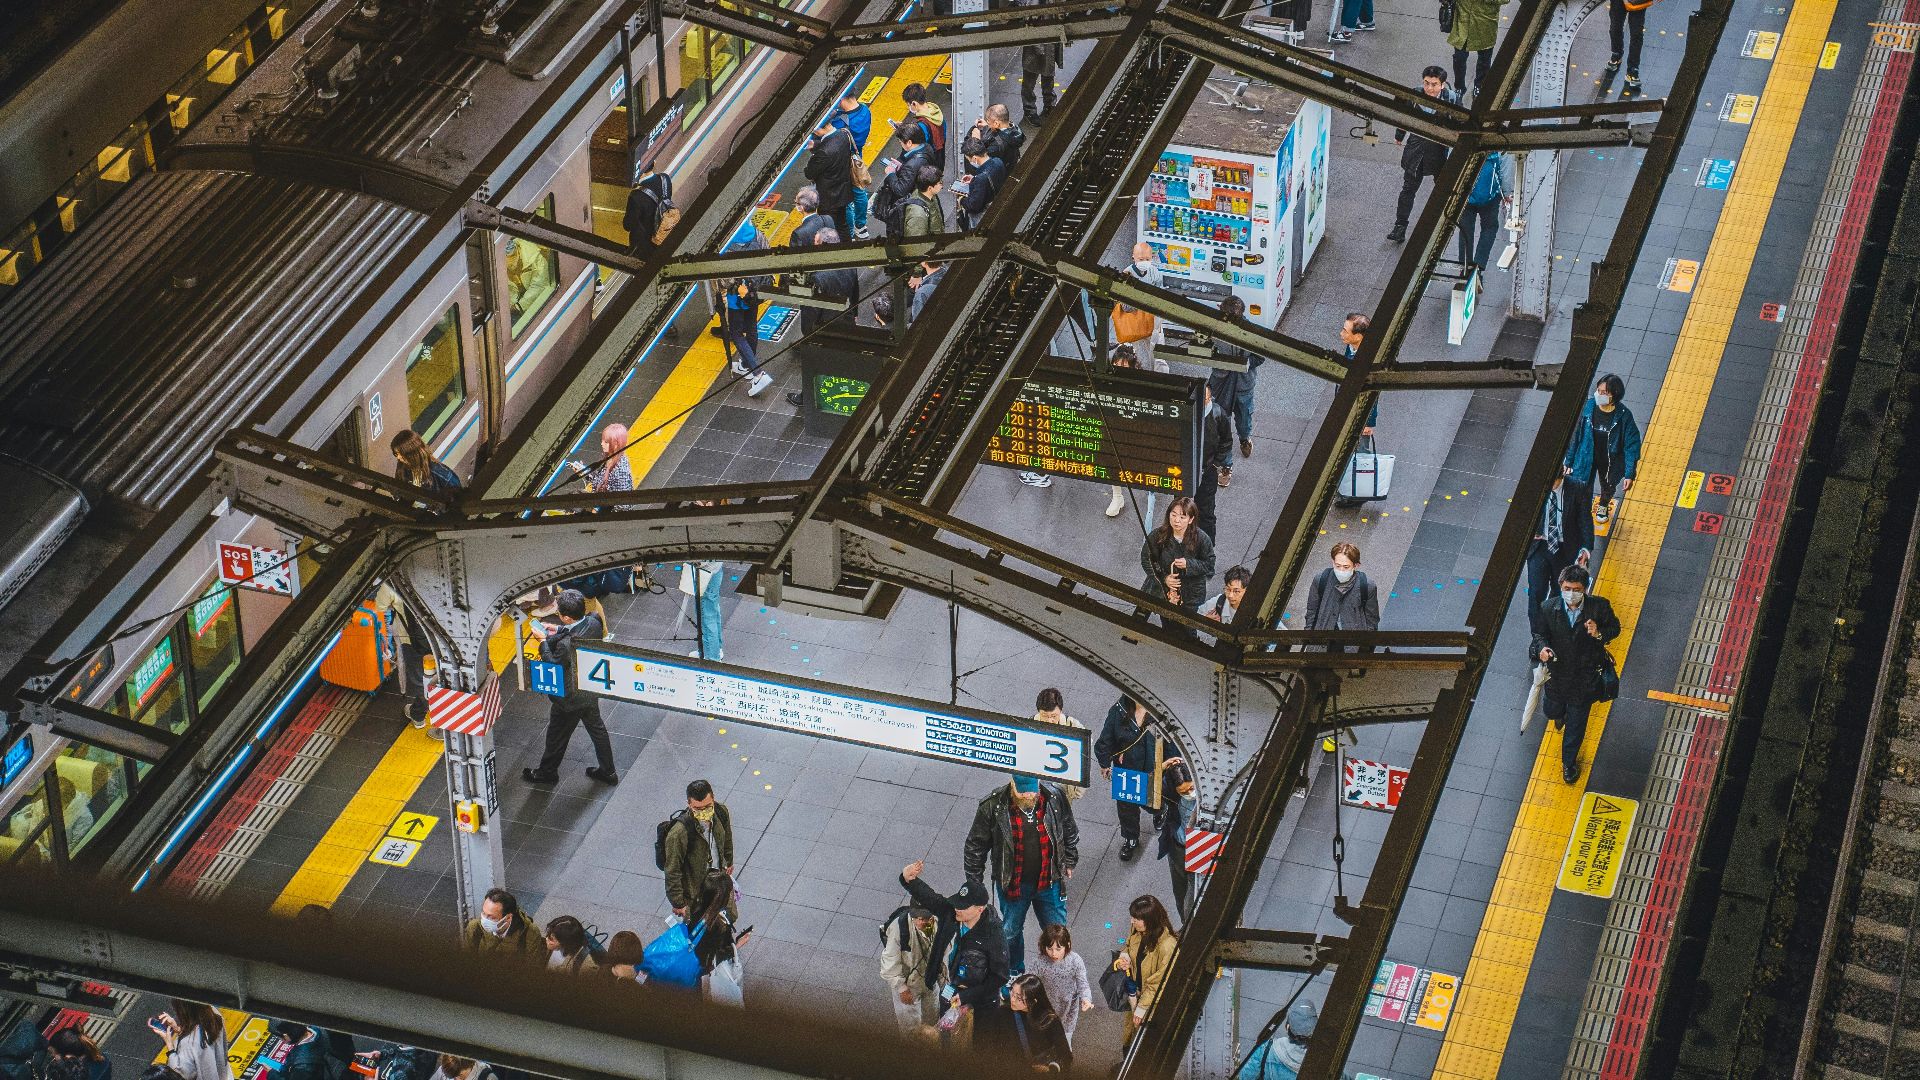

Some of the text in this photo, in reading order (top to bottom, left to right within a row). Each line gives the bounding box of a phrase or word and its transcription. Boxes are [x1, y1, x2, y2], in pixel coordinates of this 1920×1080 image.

[1169, 405, 1180, 418] 3
[1011, 414, 1050, 430] 20:24
[1011, 427, 1050, 443] 20:30
[1011, 440, 1050, 456] 20:36
[1050, 446, 1094, 463] Tottori
[224, 549, 248, 561] SOS
[534, 663, 557, 686] 11
[588, 659, 616, 690] 4
[636, 683, 644, 691] A
[975, 739, 992, 748] SUPER
[975, 751, 1014, 765] HAMAKAZE
[1044, 740, 1069, 774] 3
[1357, 765, 1386, 777] 非常
[1117, 771, 1141, 794] 11
[1357, 774, 1386, 785] ボタン
[1570, 816, 1603, 877] Watch your step
[1438, 980, 1454, 990] 9
